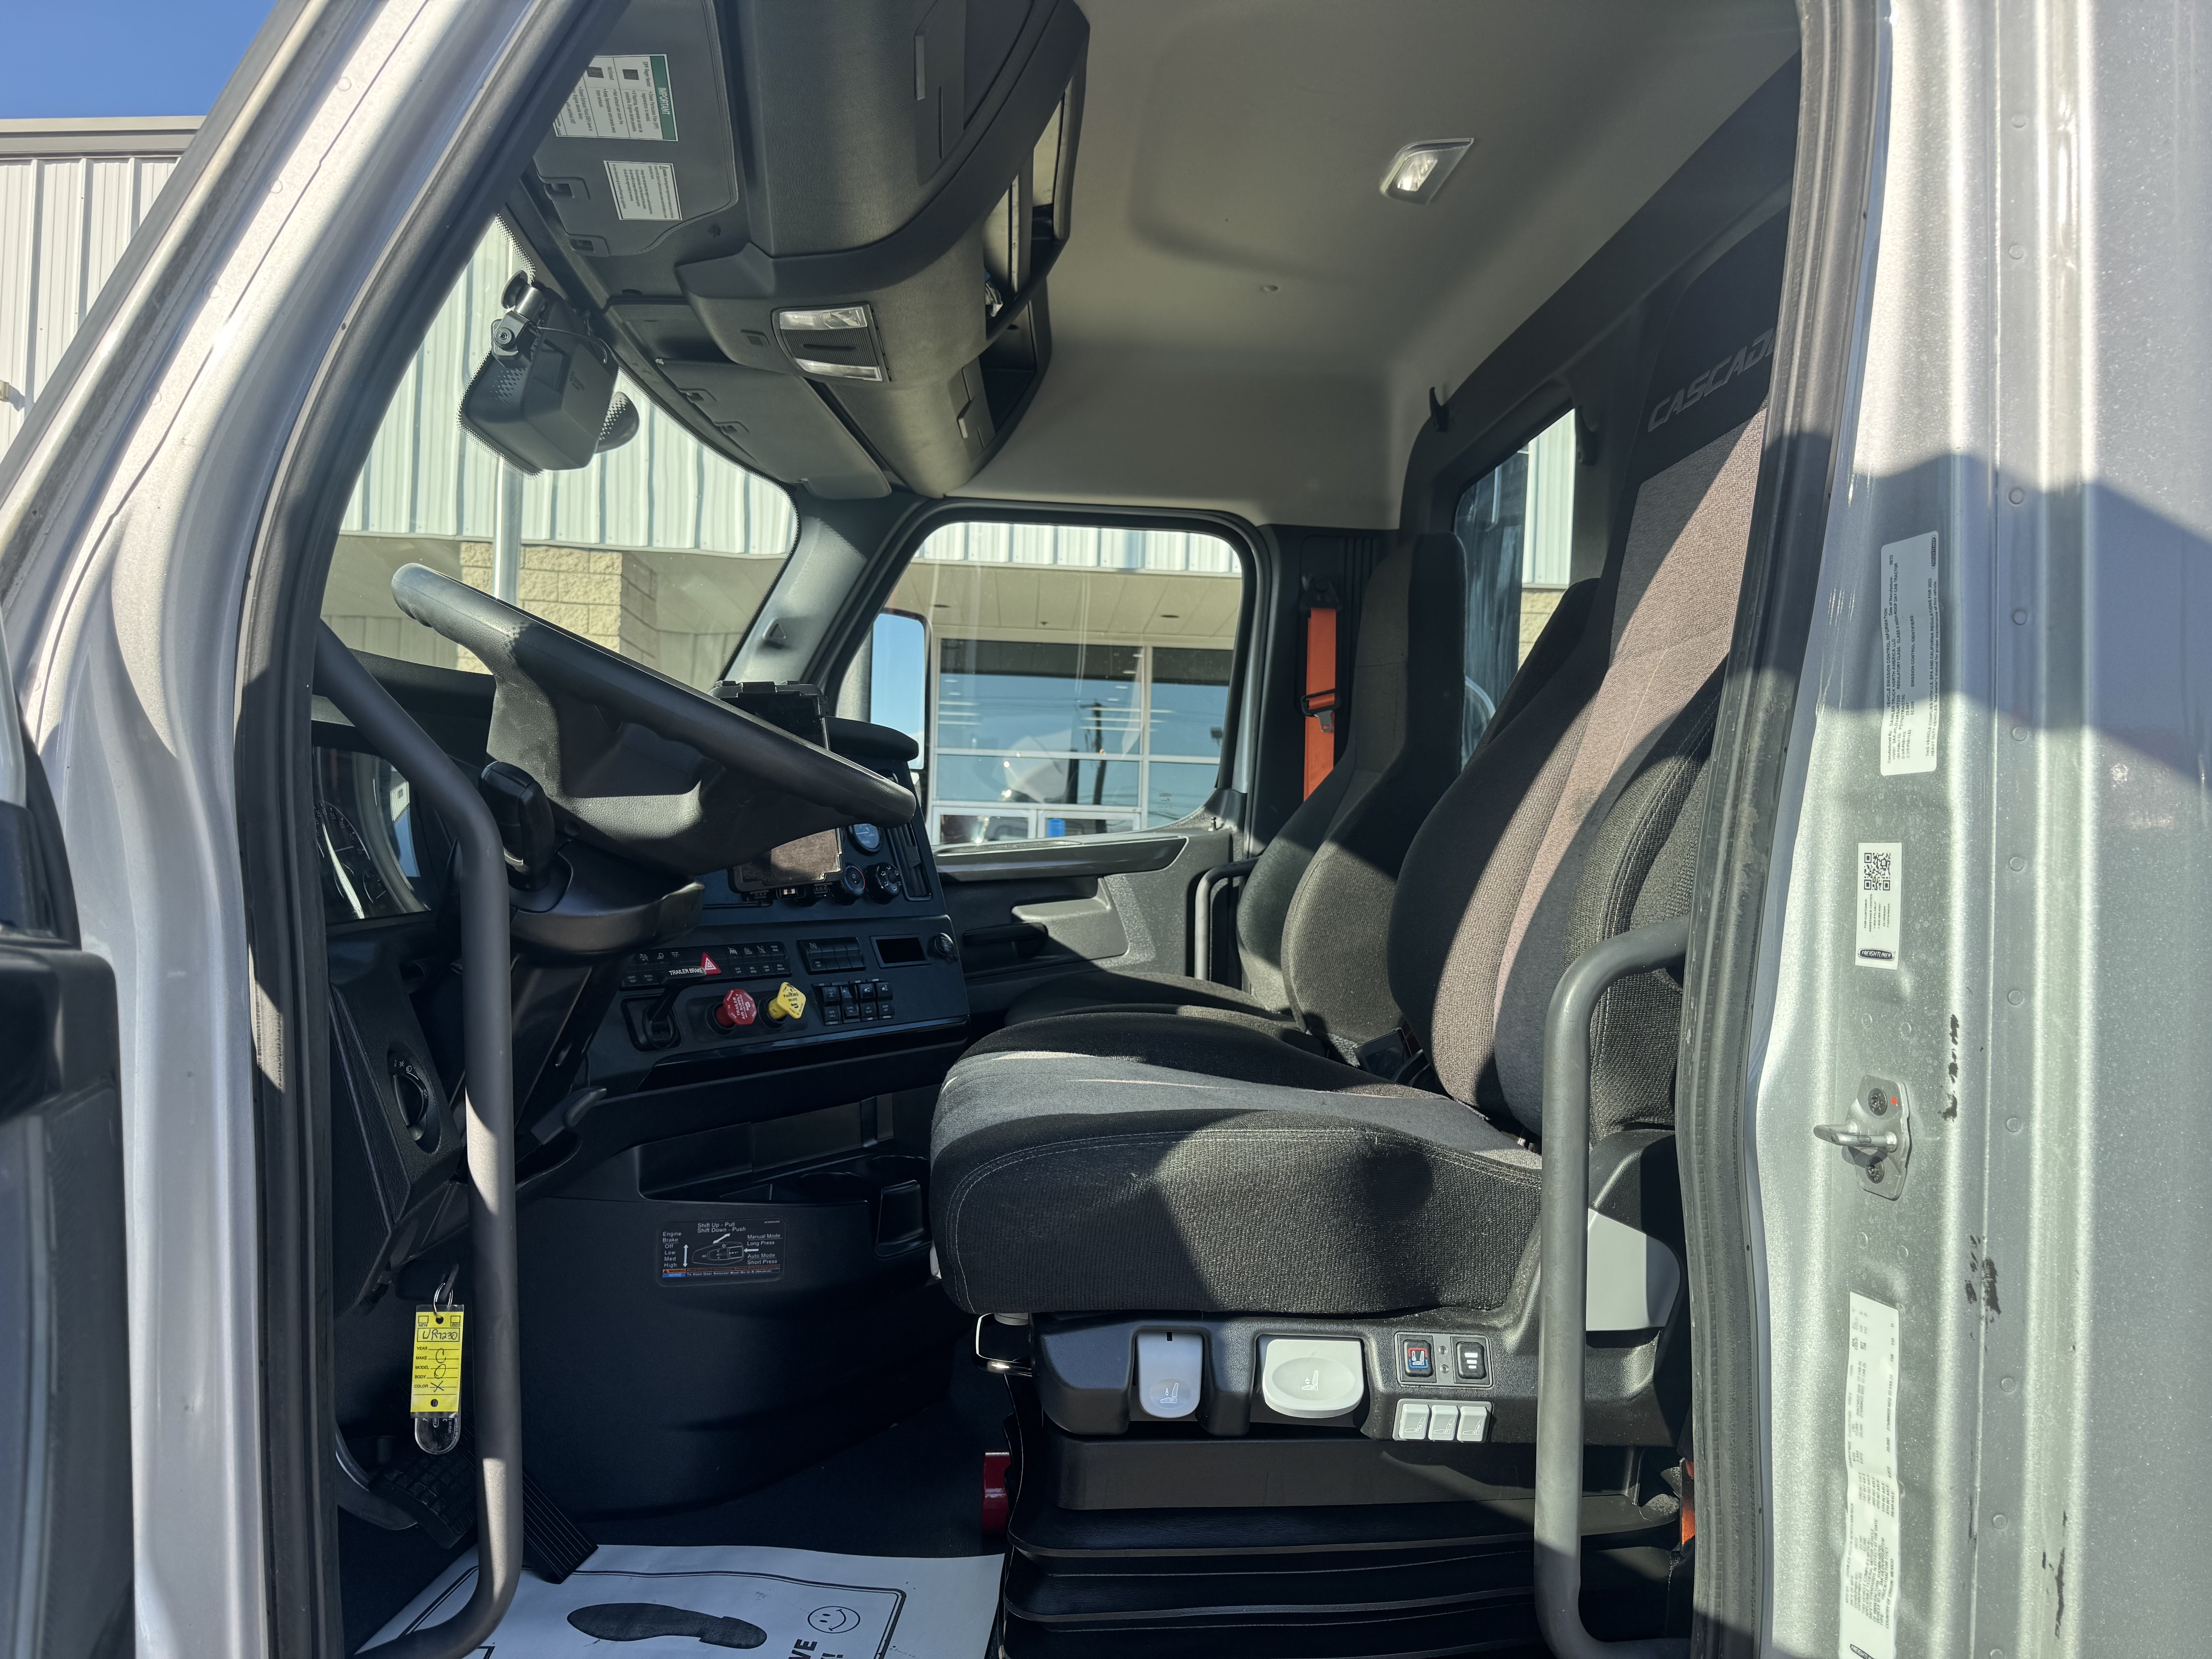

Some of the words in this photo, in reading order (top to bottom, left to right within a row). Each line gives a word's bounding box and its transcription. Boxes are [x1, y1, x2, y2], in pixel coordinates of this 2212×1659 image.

[658, 88, 670, 115] IMPORTANT
[733, 997, 741, 1016] TRAILER
[1886, 1597, 1890, 1606] OF
